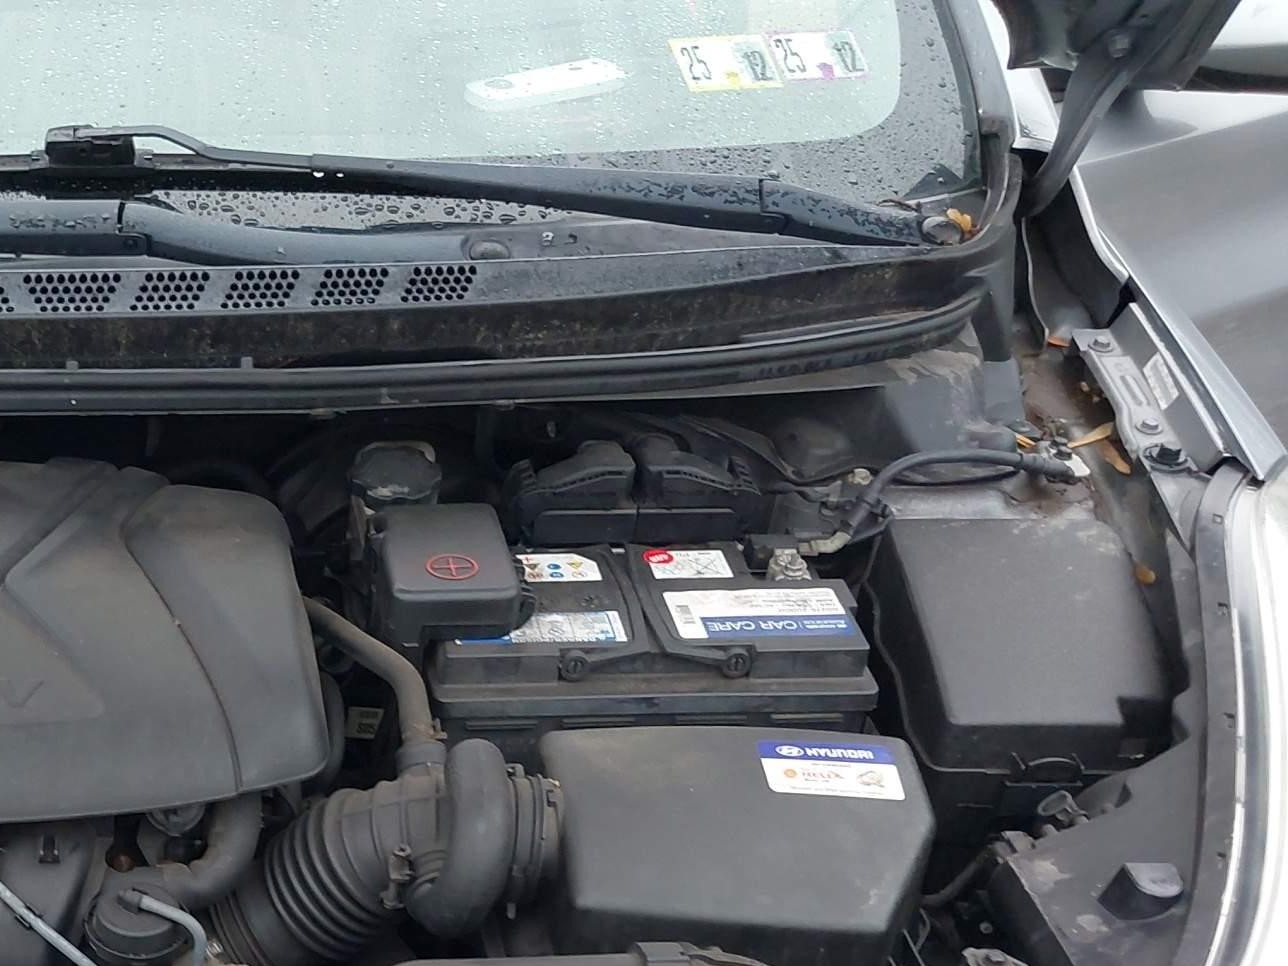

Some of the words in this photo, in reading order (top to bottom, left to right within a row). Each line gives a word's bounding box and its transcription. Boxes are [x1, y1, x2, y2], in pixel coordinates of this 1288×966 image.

[774, 38, 807, 74] 25
[834, 40, 865, 73] 12
[680, 45, 713, 82] 25
[742, 50, 774, 82] 12
[708, 621, 756, 633] CARE
[759, 620, 797, 631] CAR
[804, 747, 875, 760] HYUNDAI
